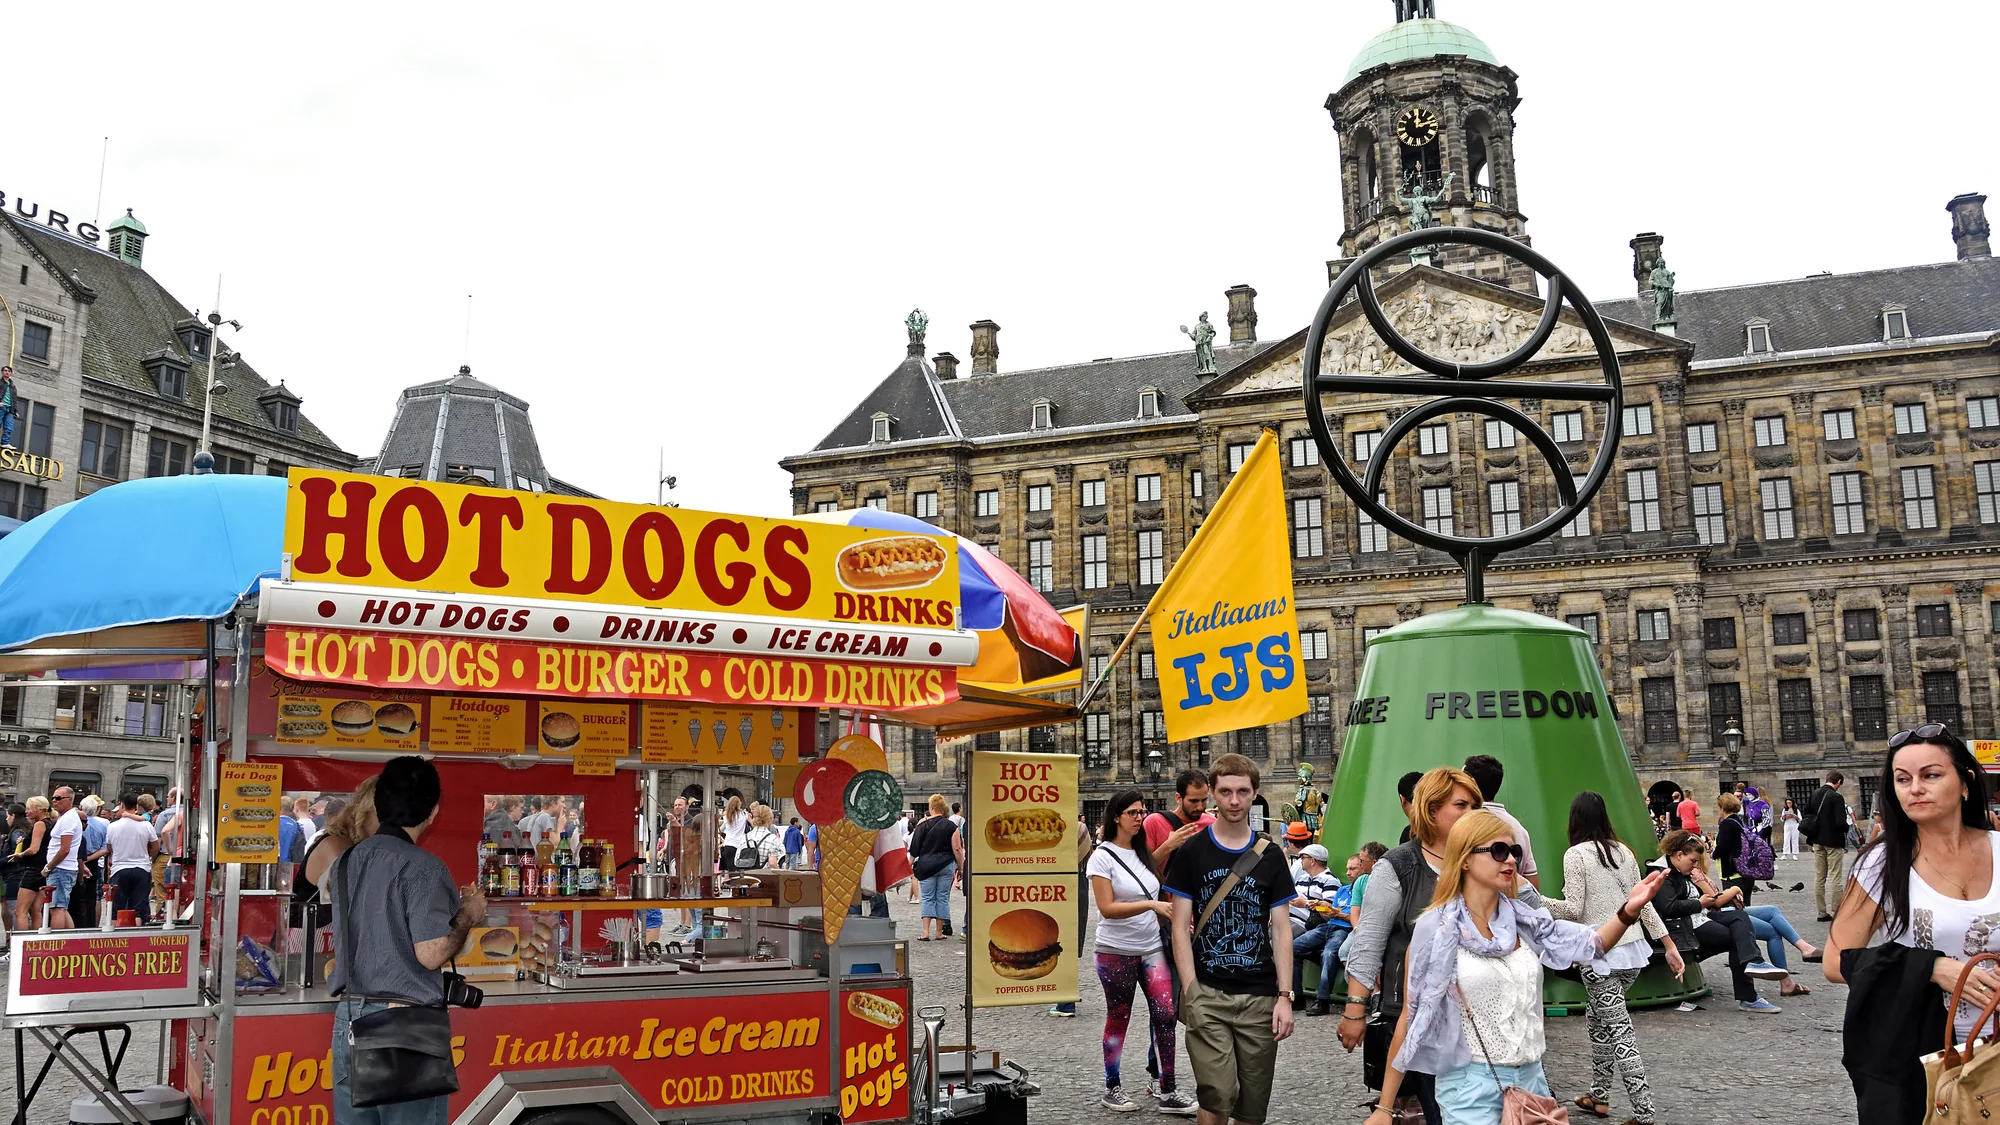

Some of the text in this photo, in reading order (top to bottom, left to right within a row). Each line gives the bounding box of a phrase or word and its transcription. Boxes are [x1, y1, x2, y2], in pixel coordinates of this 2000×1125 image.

[0, 190, 100, 241] URG
[0, 448, 64, 481] SAUD
[294, 477, 812, 612] HOT DOGS
[359, 599, 531, 632] HOT DOGS
[834, 591, 954, 627] DRINKS
[1168, 596, 1287, 640] Italiaans
[600, 616, 717, 645] DRINKS
[767, 627, 910, 657] ICE CREAM
[285, 631, 376, 681] HOT
[387, 637, 500, 688] DOGS
[536, 646, 692, 696] BURGER
[723, 657, 814, 702] COLD
[824, 663, 946, 707] DRINKS
[1172, 631, 1295, 710] IJS
[449, 698, 510, 716] Hotdogs
[582, 714, 627, 725] BURGER
[1425, 690, 1599, 720] FREEDOM
[224, 771, 278, 782] Hot Dogs
[1000, 762, 1053, 781] HOT
[992, 784, 1060, 803] DOGS
[995, 857, 1034, 865] TOPPINGS
[984, 885, 1067, 904] BURGER
[25, 940, 67, 952] KETCHUP
[88, 938, 129, 949] MAYONAISE
[149, 935, 187, 947] MOSTERD
[28, 950, 183, 981] TOPPINGS FREE
[995, 984, 1057, 994] TOPPINGS FREE
[489, 1030, 631, 1067] Italian
[845, 1033, 897, 1079] Hot
[246, 1048, 334, 1102] Hot
[661, 1068, 815, 1107] COLD DRINKS
[840, 1062, 908, 1120] Dogs
[250, 1104, 330, 1125] COLD
